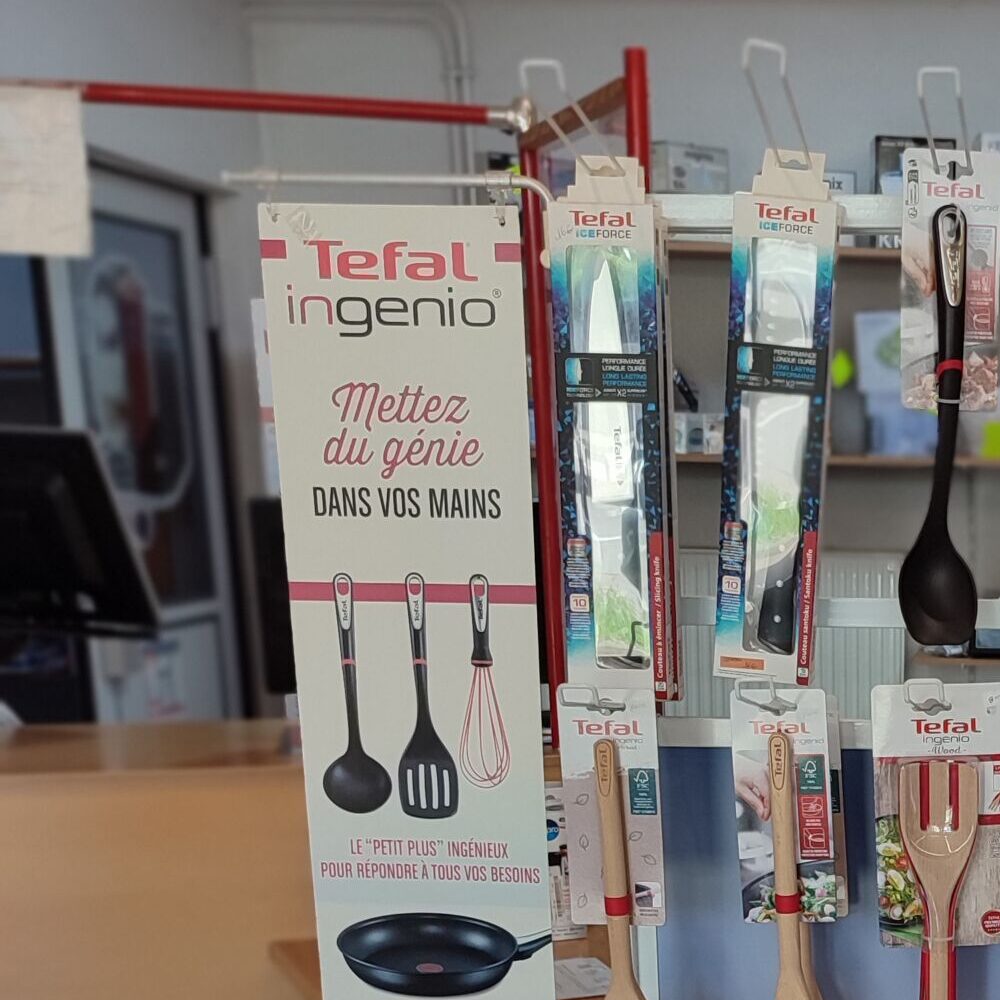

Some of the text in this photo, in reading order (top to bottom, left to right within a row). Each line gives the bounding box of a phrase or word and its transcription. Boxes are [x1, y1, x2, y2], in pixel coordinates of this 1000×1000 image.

[922, 181, 985, 199] Tefal
[569, 210, 637, 228] Tefal
[755, 202, 819, 224] Tefal
[575, 229, 632, 239] ICEFORCE
[759, 221, 814, 235] ICEFORCE
[304, 239, 479, 282] Tefal
[773, 349, 817, 359] PERFORMANCE
[331, 382, 470, 432] Mettez
[323, 427, 485, 480] du génie
[312, 486, 502, 519] DANS VOS MAINS
[652, 556, 661, 576] knife
[805, 548, 813, 568] knife
[653, 576, 662, 603] Slicing
[724, 580, 739, 590] 10
[803, 568, 812, 598] Santoku
[655, 610, 663, 641] émincer
[802, 605, 811, 634] santoku
[800, 635, 809, 665] Couteau
[656, 648, 664, 679] Couteau
[572, 720, 643, 736] Tefal
[749, 720, 810, 735] Tefal
[911, 718, 982, 735] Tefal
[922, 735, 970, 746] ingenio
[773, 741, 783, 777] Tefal
[350, 838, 363, 855] LE
[447, 837, 509, 859] INGÉNIEUX
[320, 859, 541, 884] POUR RÉPONDRE À TOUS VOS BESOINS
